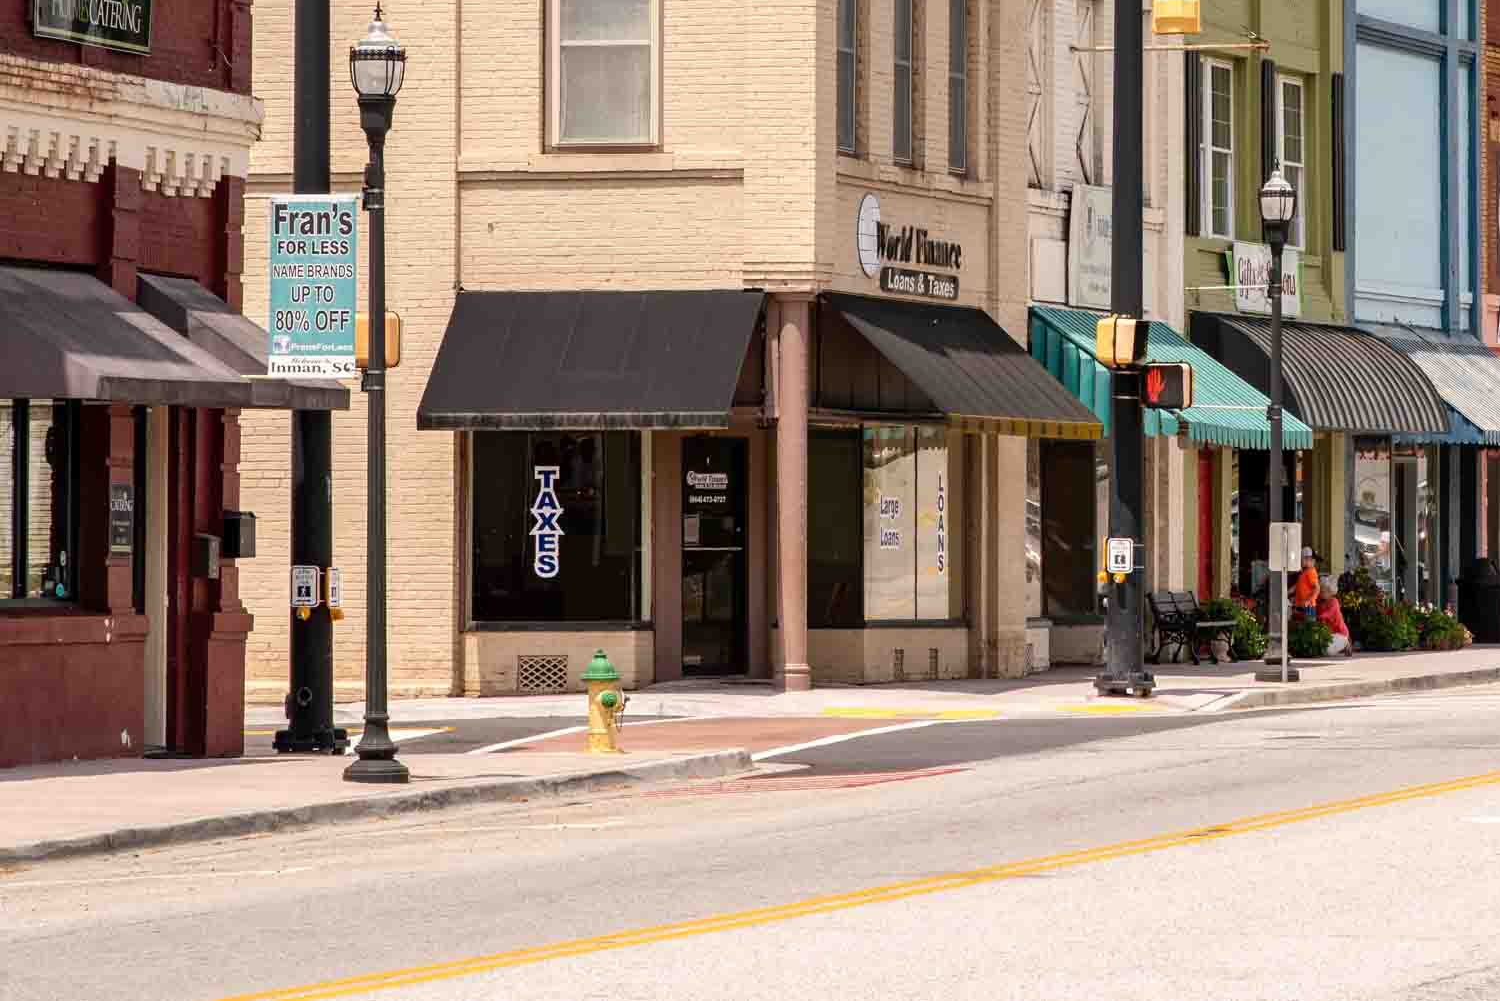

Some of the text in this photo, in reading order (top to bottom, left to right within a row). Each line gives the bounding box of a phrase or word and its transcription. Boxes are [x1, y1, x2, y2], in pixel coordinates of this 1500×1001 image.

[274, 203, 353, 235] Fran's
[277, 240, 349, 255] FOR LESS
[876, 220, 961, 269] World Finance
[273, 264, 353, 278] NAME BRANDS
[887, 268, 955, 297] Loans & Taxes
[291, 285, 334, 303] UP TO
[275, 310, 350, 331] 80% OFF
[271, 362, 354, 374] Inman, SC
[880, 495, 899, 519] Large
[530, 466, 564, 577] TAXES
[880, 527, 900, 547] Loans
